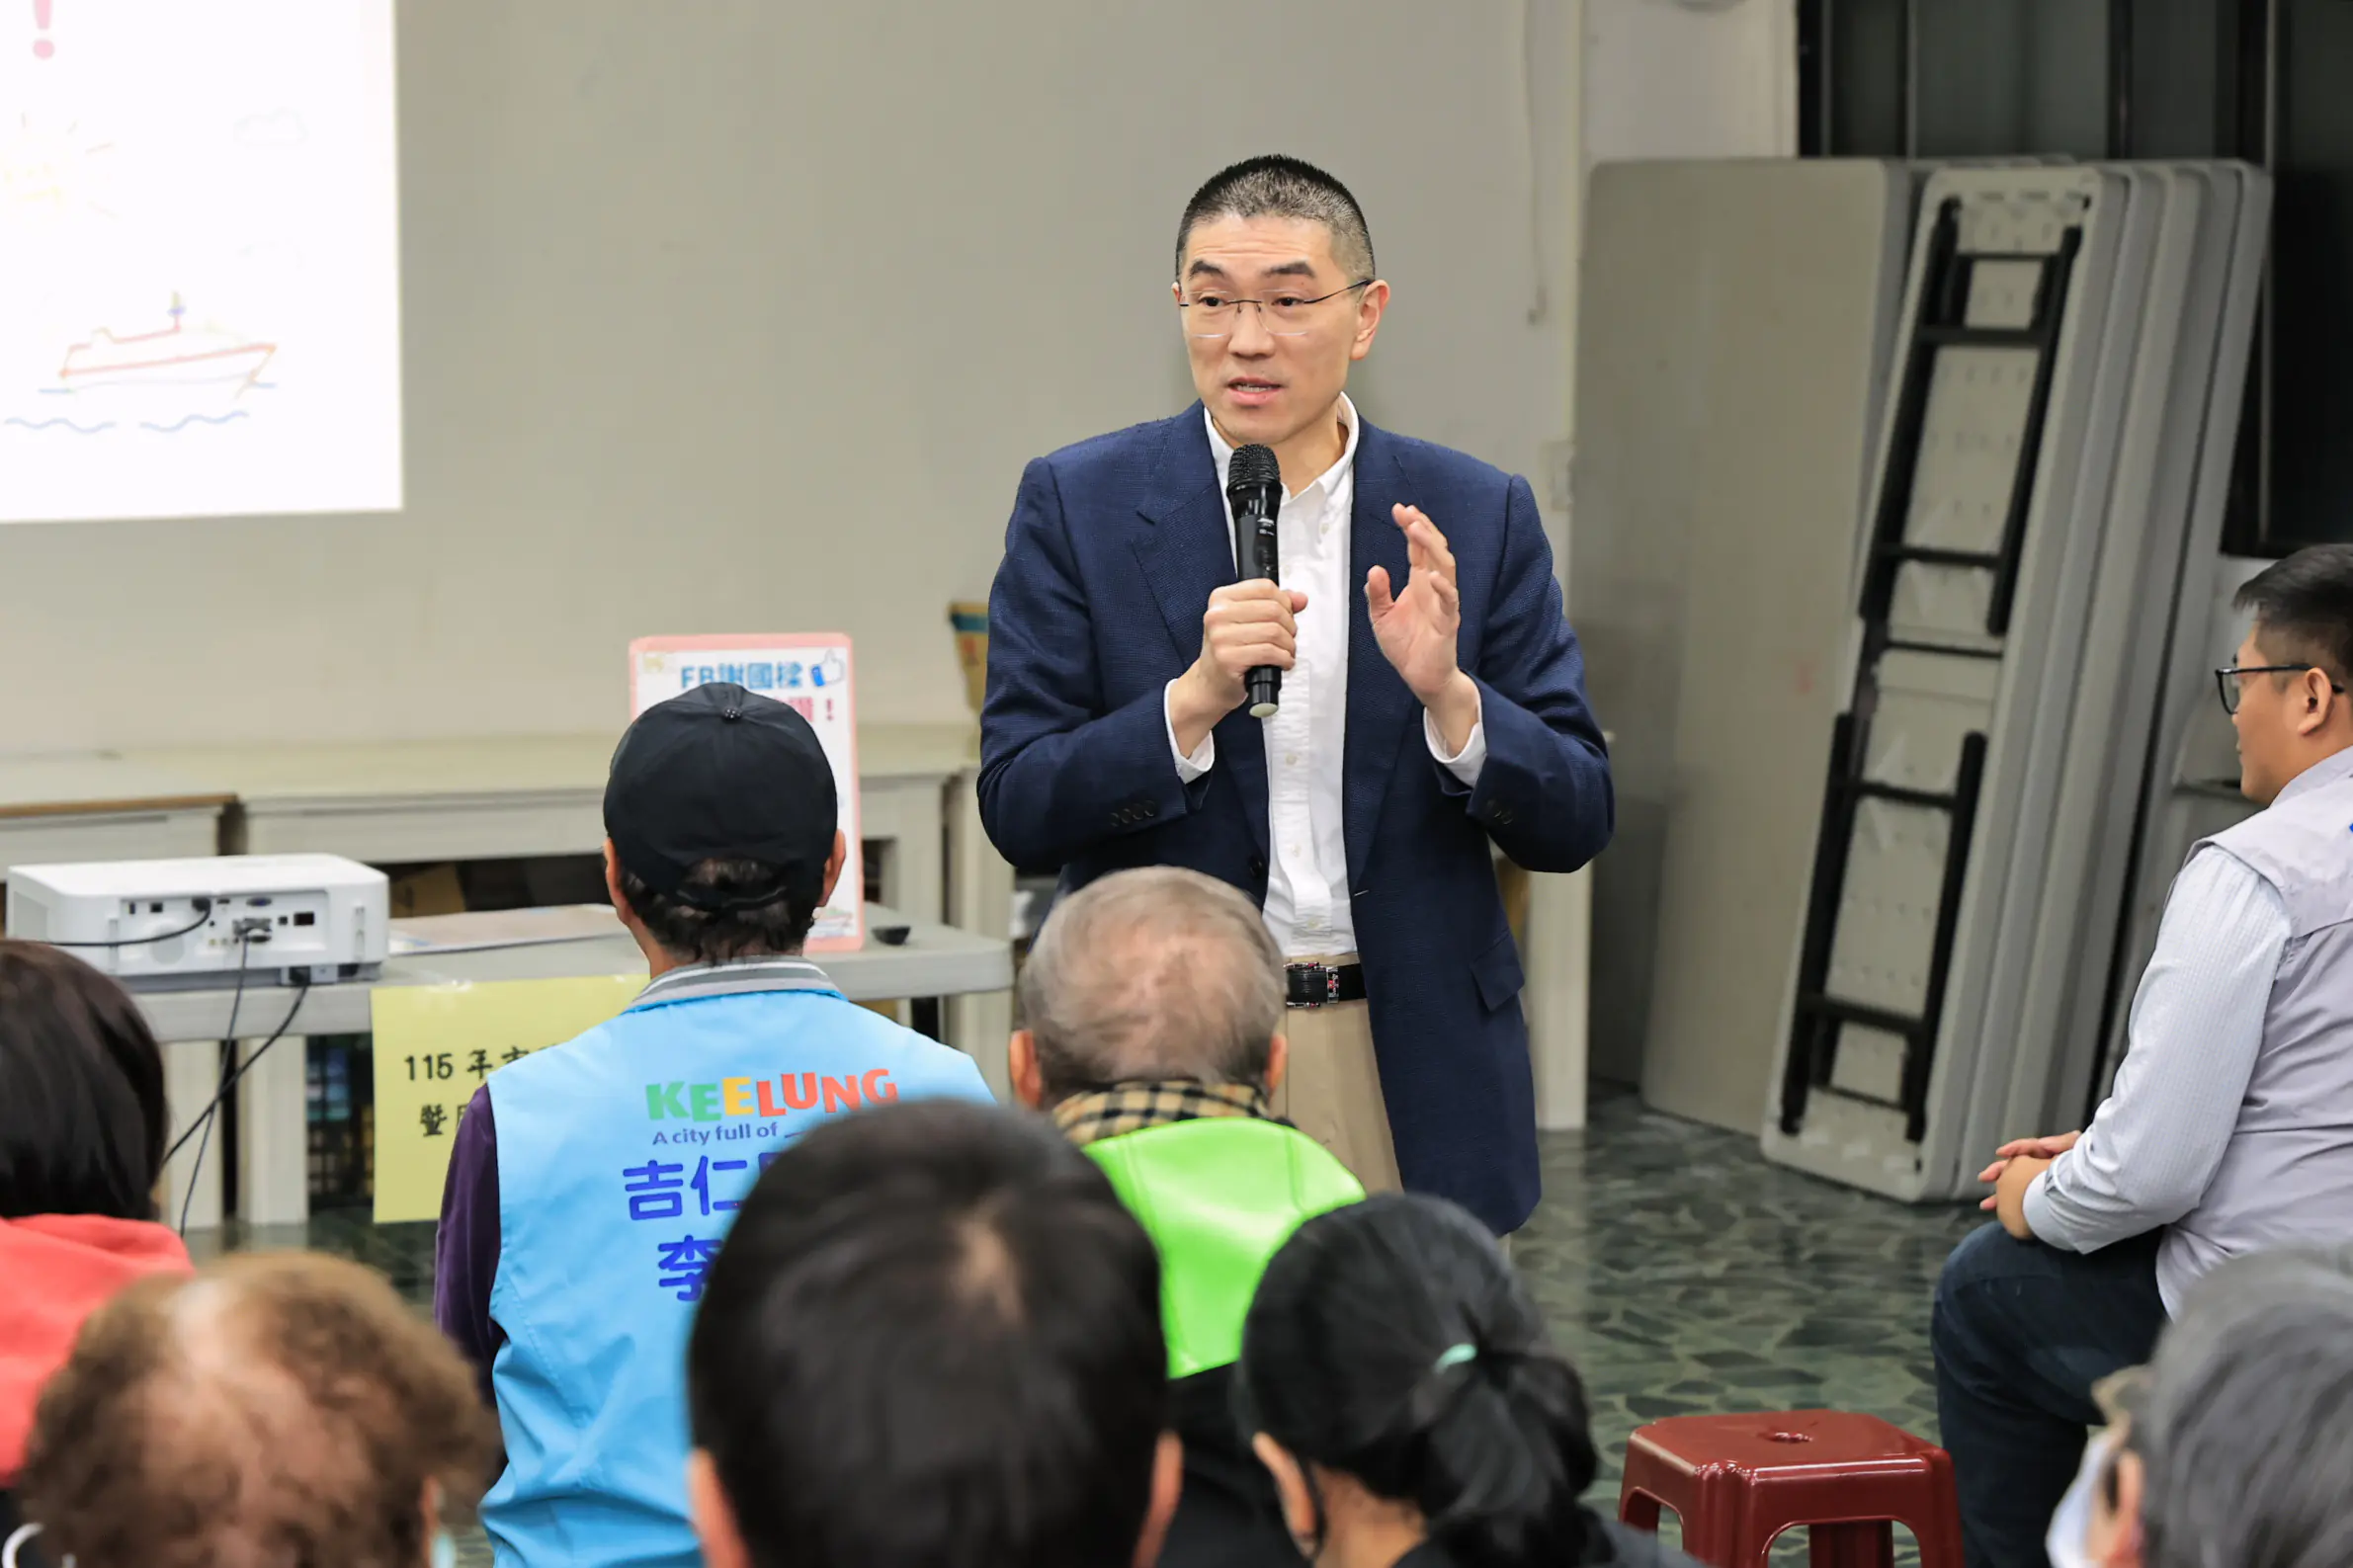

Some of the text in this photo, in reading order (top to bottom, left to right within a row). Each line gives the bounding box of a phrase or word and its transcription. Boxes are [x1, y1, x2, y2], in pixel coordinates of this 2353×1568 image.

[645, 1068, 899, 1121] KEELUNG
[652, 1121, 779, 1146] A city full of
[623, 1153, 781, 1221] 吉仁
